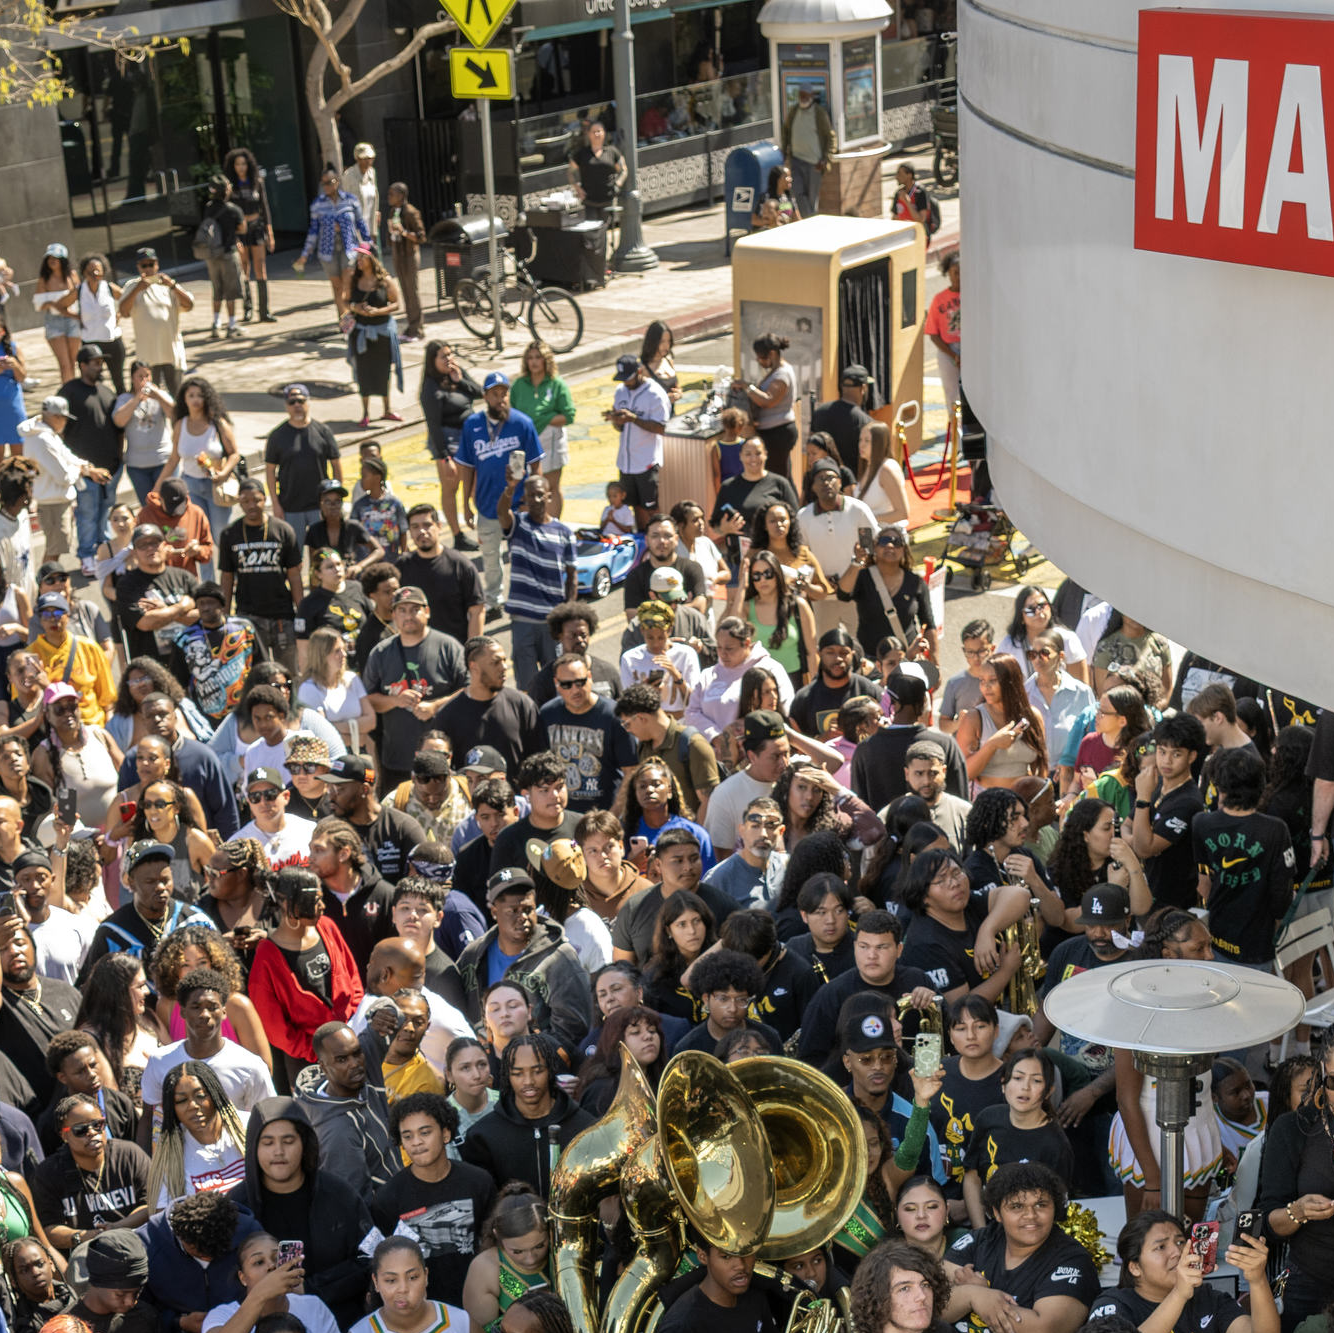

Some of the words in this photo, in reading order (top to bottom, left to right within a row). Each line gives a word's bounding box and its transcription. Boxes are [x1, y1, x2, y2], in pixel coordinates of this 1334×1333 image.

[473, 434, 520, 457] Dodgers
[547, 725, 603, 756] YANKEES
[1205, 832, 1265, 868] BORN
[1090, 896, 1104, 916] LA
[1057, 1266, 1081, 1276] BORN
[1067, 1277, 1078, 1285] LA
